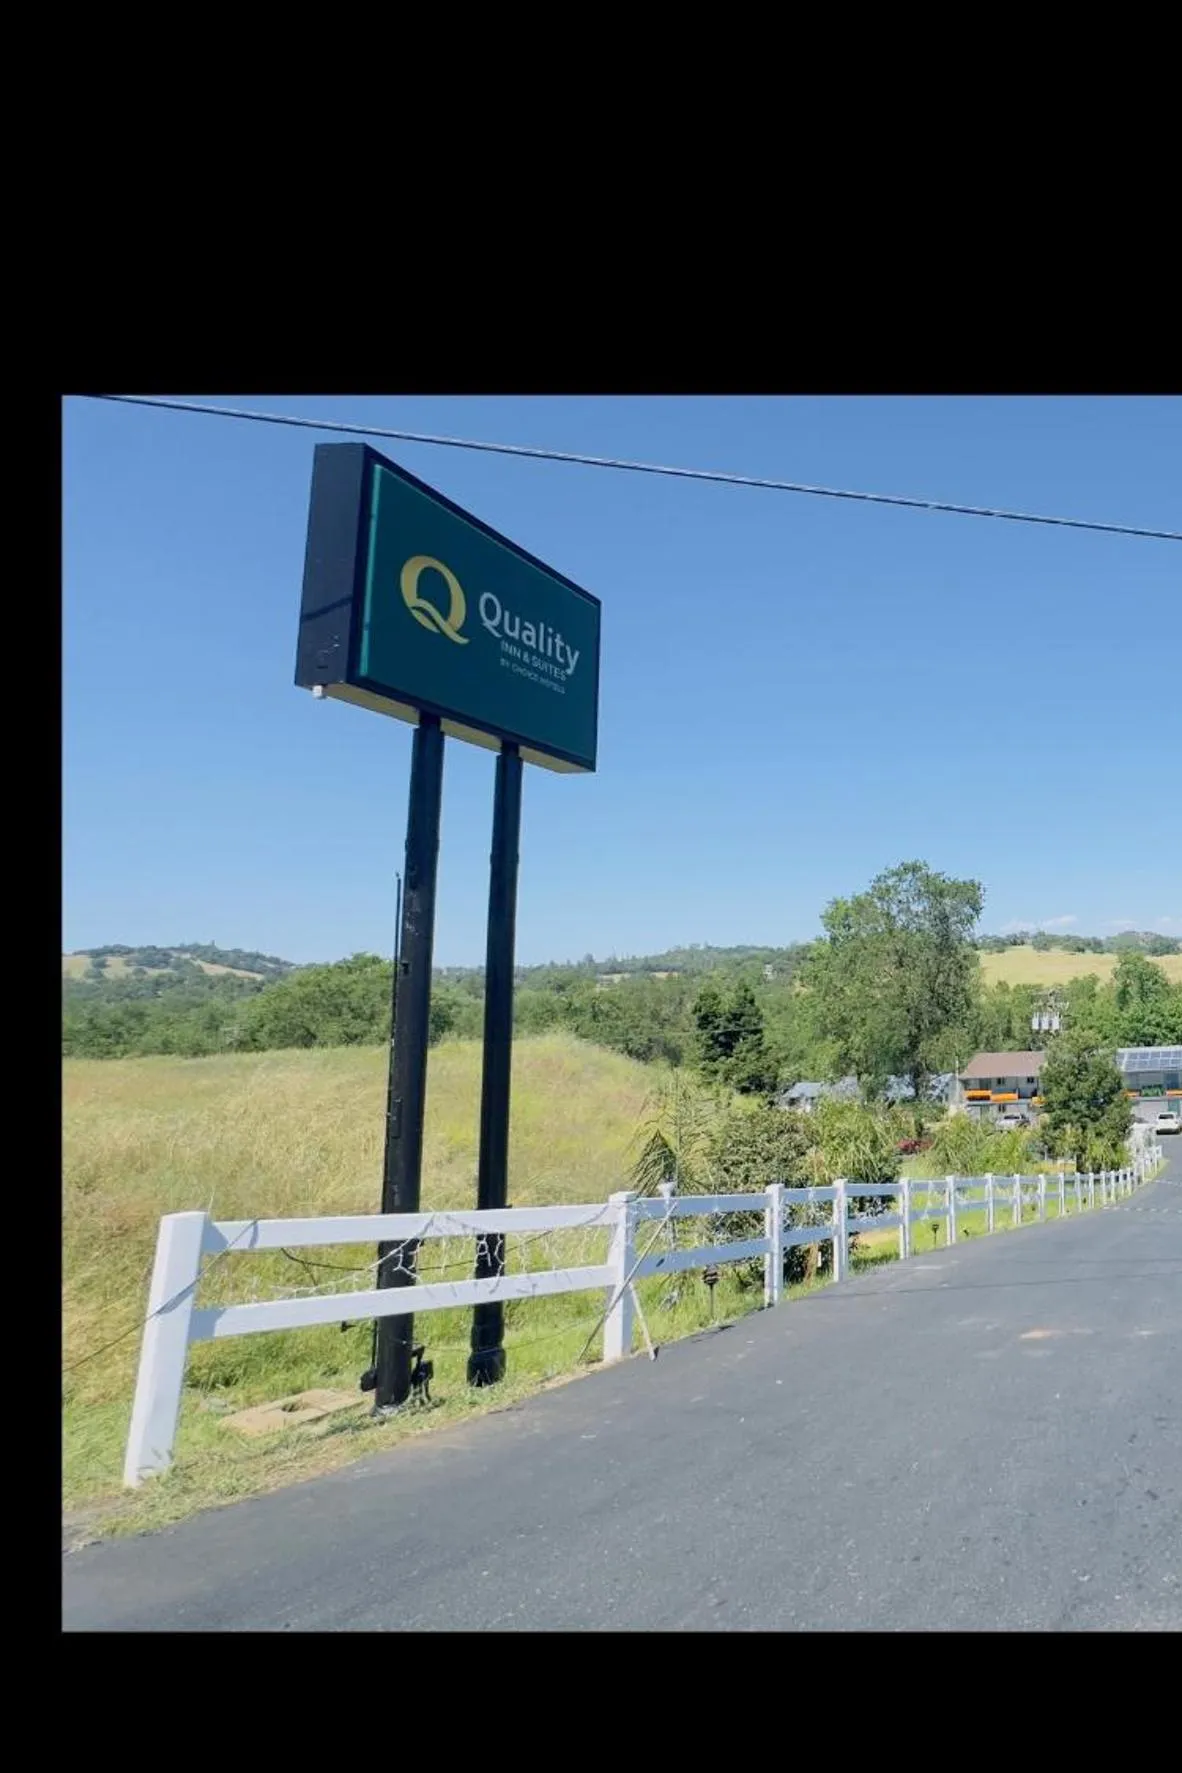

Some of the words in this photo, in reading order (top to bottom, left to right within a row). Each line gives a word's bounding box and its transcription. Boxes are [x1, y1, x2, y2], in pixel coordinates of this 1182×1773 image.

[400, 555, 470, 645] Q
[479, 592, 580, 675] Quality
[501, 640, 521, 659] INN
[532, 656, 566, 681] SUITES
